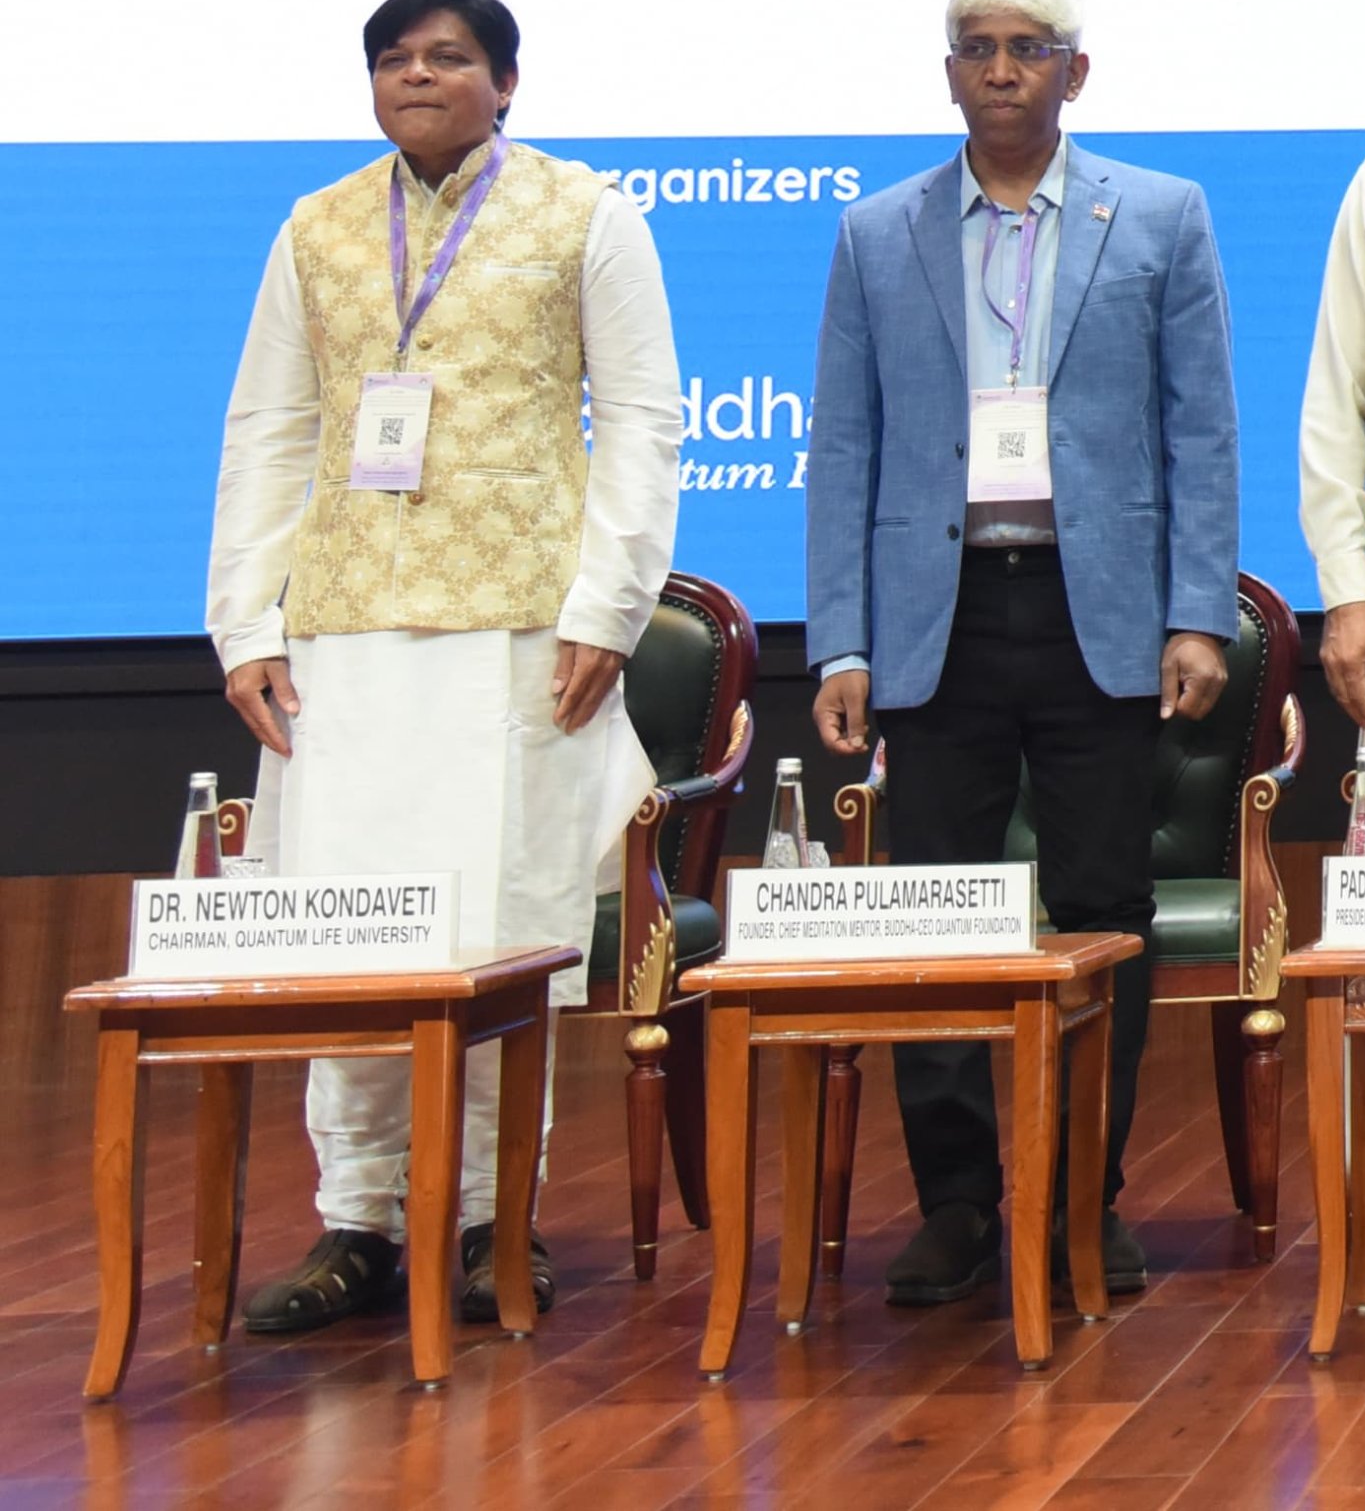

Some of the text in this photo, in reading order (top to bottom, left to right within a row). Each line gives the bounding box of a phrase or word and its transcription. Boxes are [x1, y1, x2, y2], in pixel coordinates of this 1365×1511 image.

[149, 886, 436, 923] DR. NEWTON KONDAVETI
[757, 878, 1005, 912] CHANDRA PULAMARASETTI
[149, 926, 431, 951] CHAIRMAN, QUANTUM LIFE UNIVERSITY
